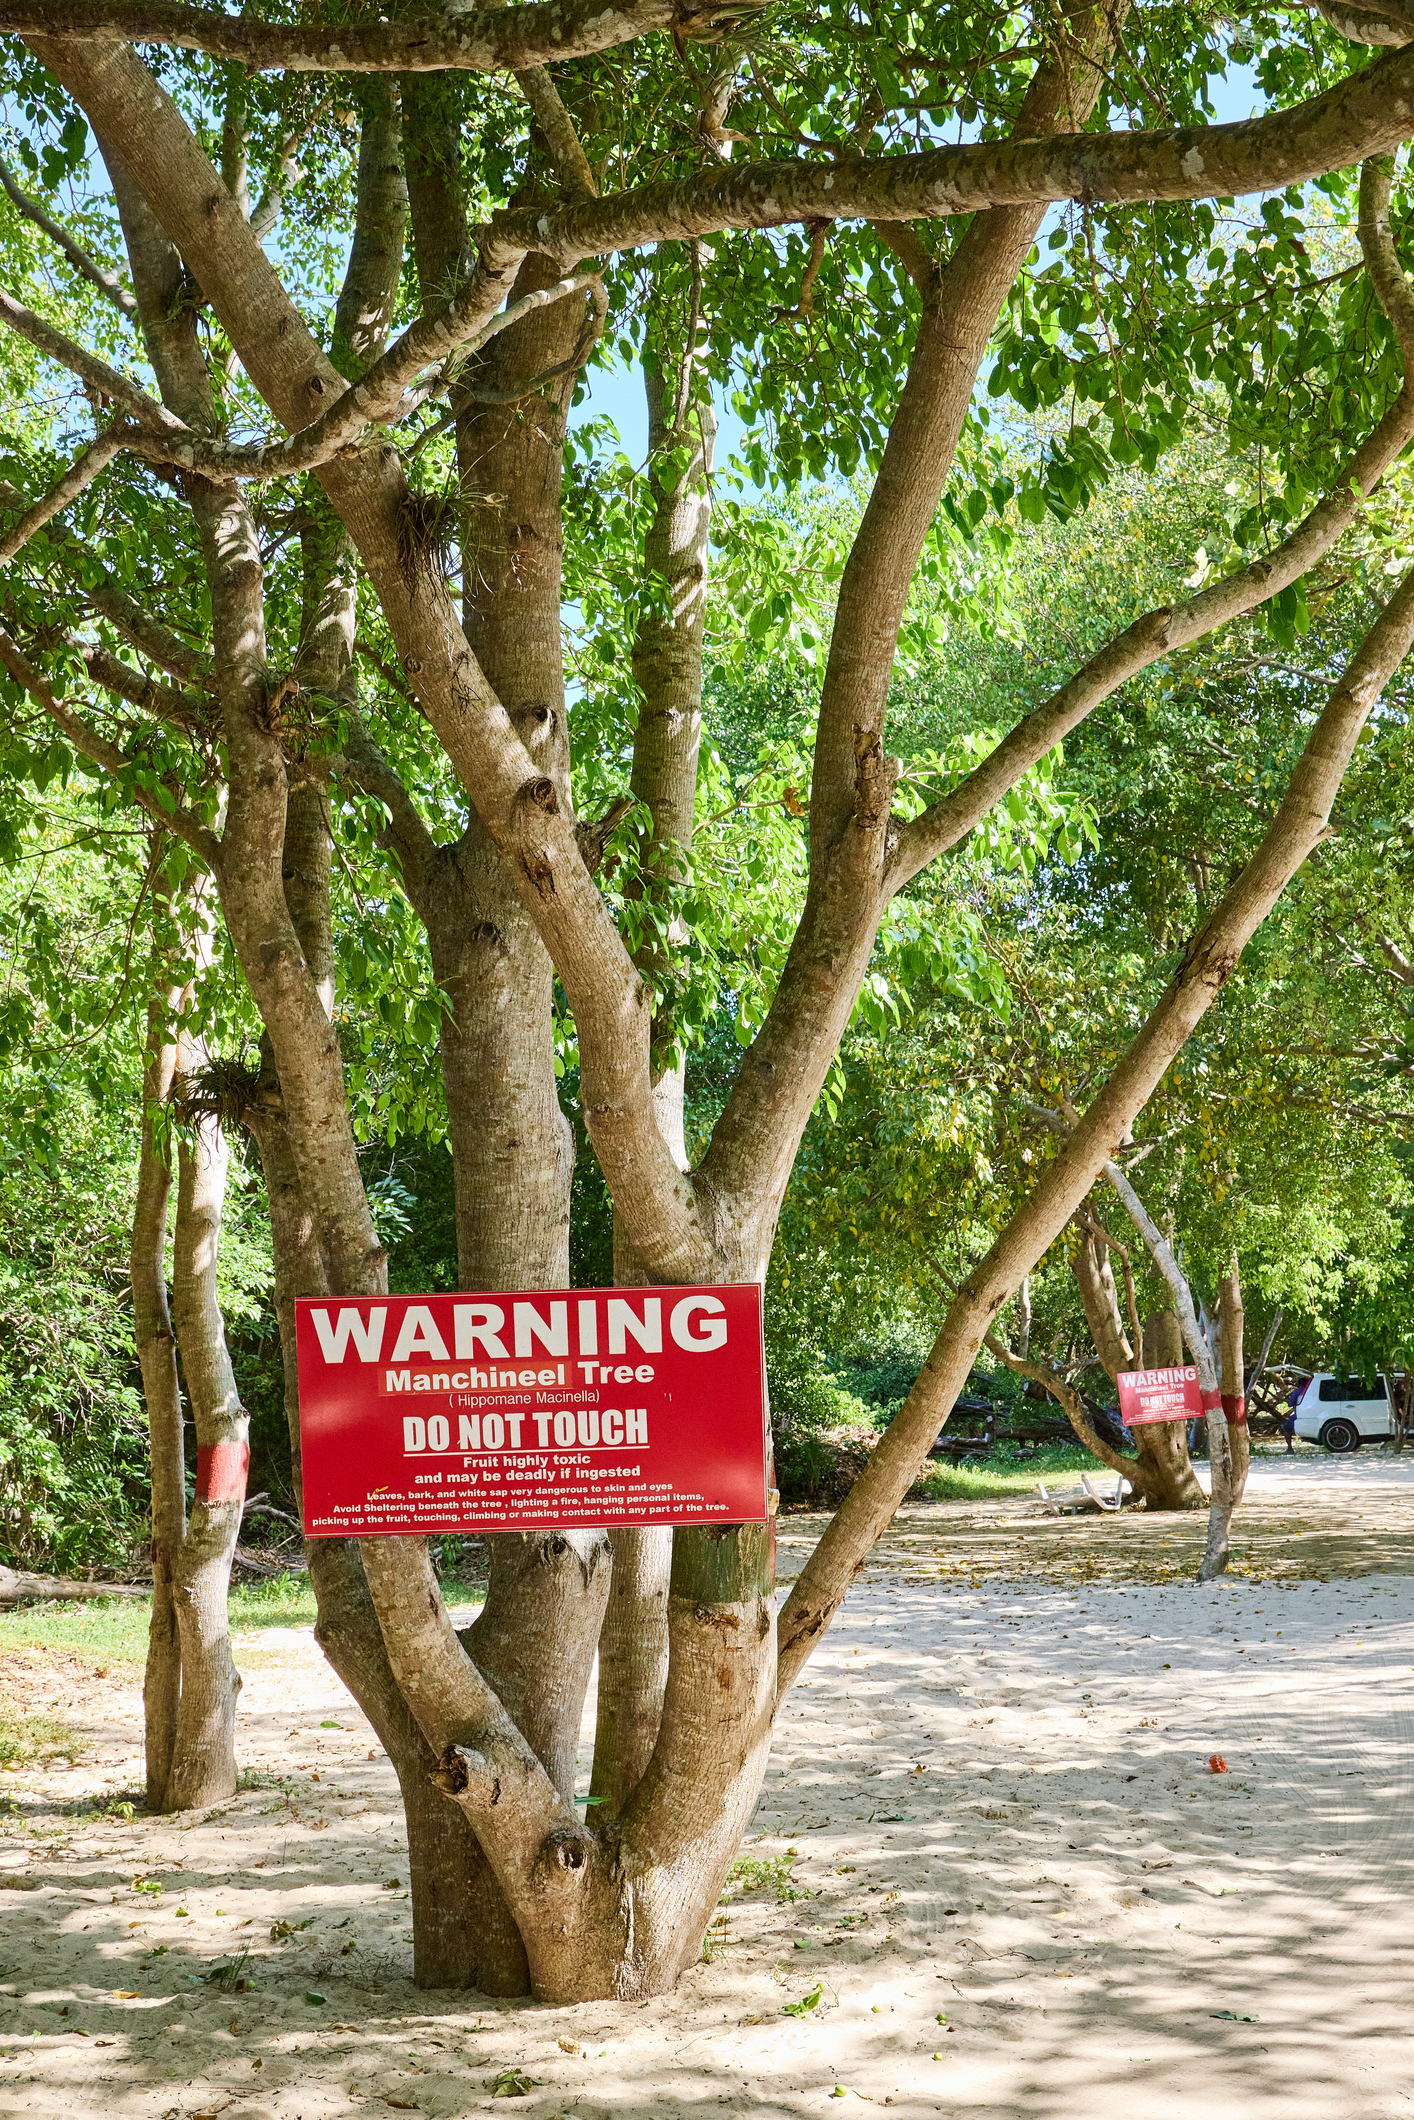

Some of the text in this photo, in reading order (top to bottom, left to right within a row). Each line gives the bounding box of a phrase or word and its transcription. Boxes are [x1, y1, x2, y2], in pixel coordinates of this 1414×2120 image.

[310, 1295, 727, 1363] WARNING
[386, 1361, 654, 1393] Manchineel Tree
[1122, 1368, 1196, 1387] WARNING
[536, 1388, 599, 1403] Macinella)
[1140, 1397, 1149, 1406] DO
[1150, 1395, 1162, 1404] NOT
[1163, 1393, 1184, 1403] TOUCH
[403, 1409, 648, 1451] DO NOT TOUCH
[464, 1453, 590, 1468] Fruit highly toxic
[415, 1465, 640, 1484] and may be deadly if ingested
[367, 1492, 405, 1501] Leaves,
[408, 1491, 434, 1499] bark,
[437, 1490, 455, 1498] and
[458, 1489, 487, 1497] white
[535, 1487, 588, 1495] dangerous
[604, 1484, 625, 1492] skin
[628, 1483, 646, 1491] and
[649, 1484, 673, 1492] eyes
[333, 1505, 361, 1513] Avoid
[364, 1503, 415, 1512] Sheltering
[418, 1501, 459, 1510] beneath
[511, 1498, 549, 1508] lighting
[561, 1497, 581, 1506] fire,
[584, 1496, 624, 1505] hanging
[627, 1493, 670, 1504] personal
[673, 1493, 704, 1501] items,
[313, 1517, 349, 1526] picking
[367, 1515, 383, 1523] the
[386, 1514, 410, 1523] fruit,
[414, 1513, 460, 1522] touching,
[463, 1511, 506, 1520] climbing
[522, 1509, 559, 1518] making
[562, 1508, 601, 1516] contact
[649, 1505, 670, 1514] part
[673, 1504, 683, 1512] of
